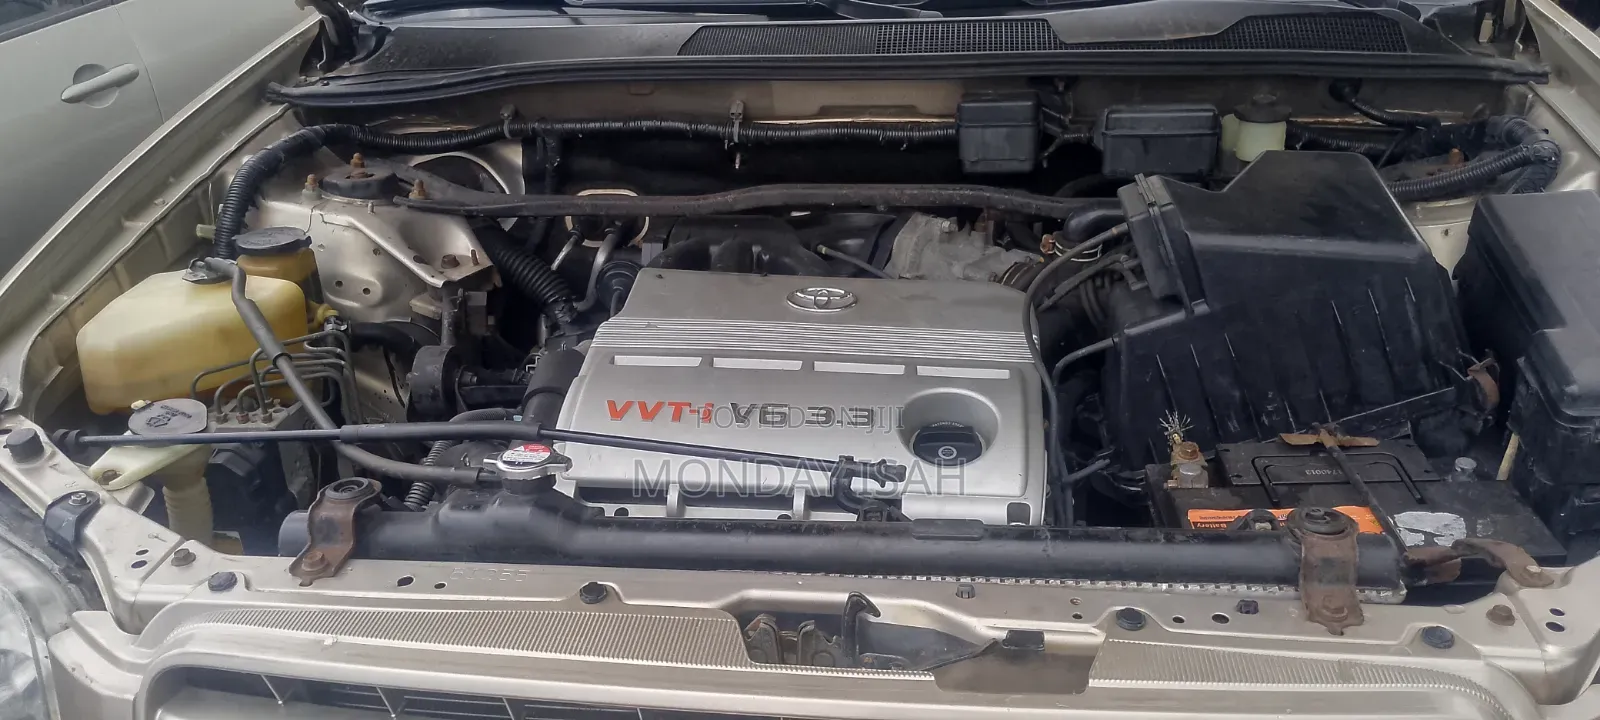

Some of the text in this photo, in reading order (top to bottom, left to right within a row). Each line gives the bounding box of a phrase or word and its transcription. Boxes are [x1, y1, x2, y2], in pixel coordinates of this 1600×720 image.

[607, 400, 875, 428] VVT-i V6 3.3
